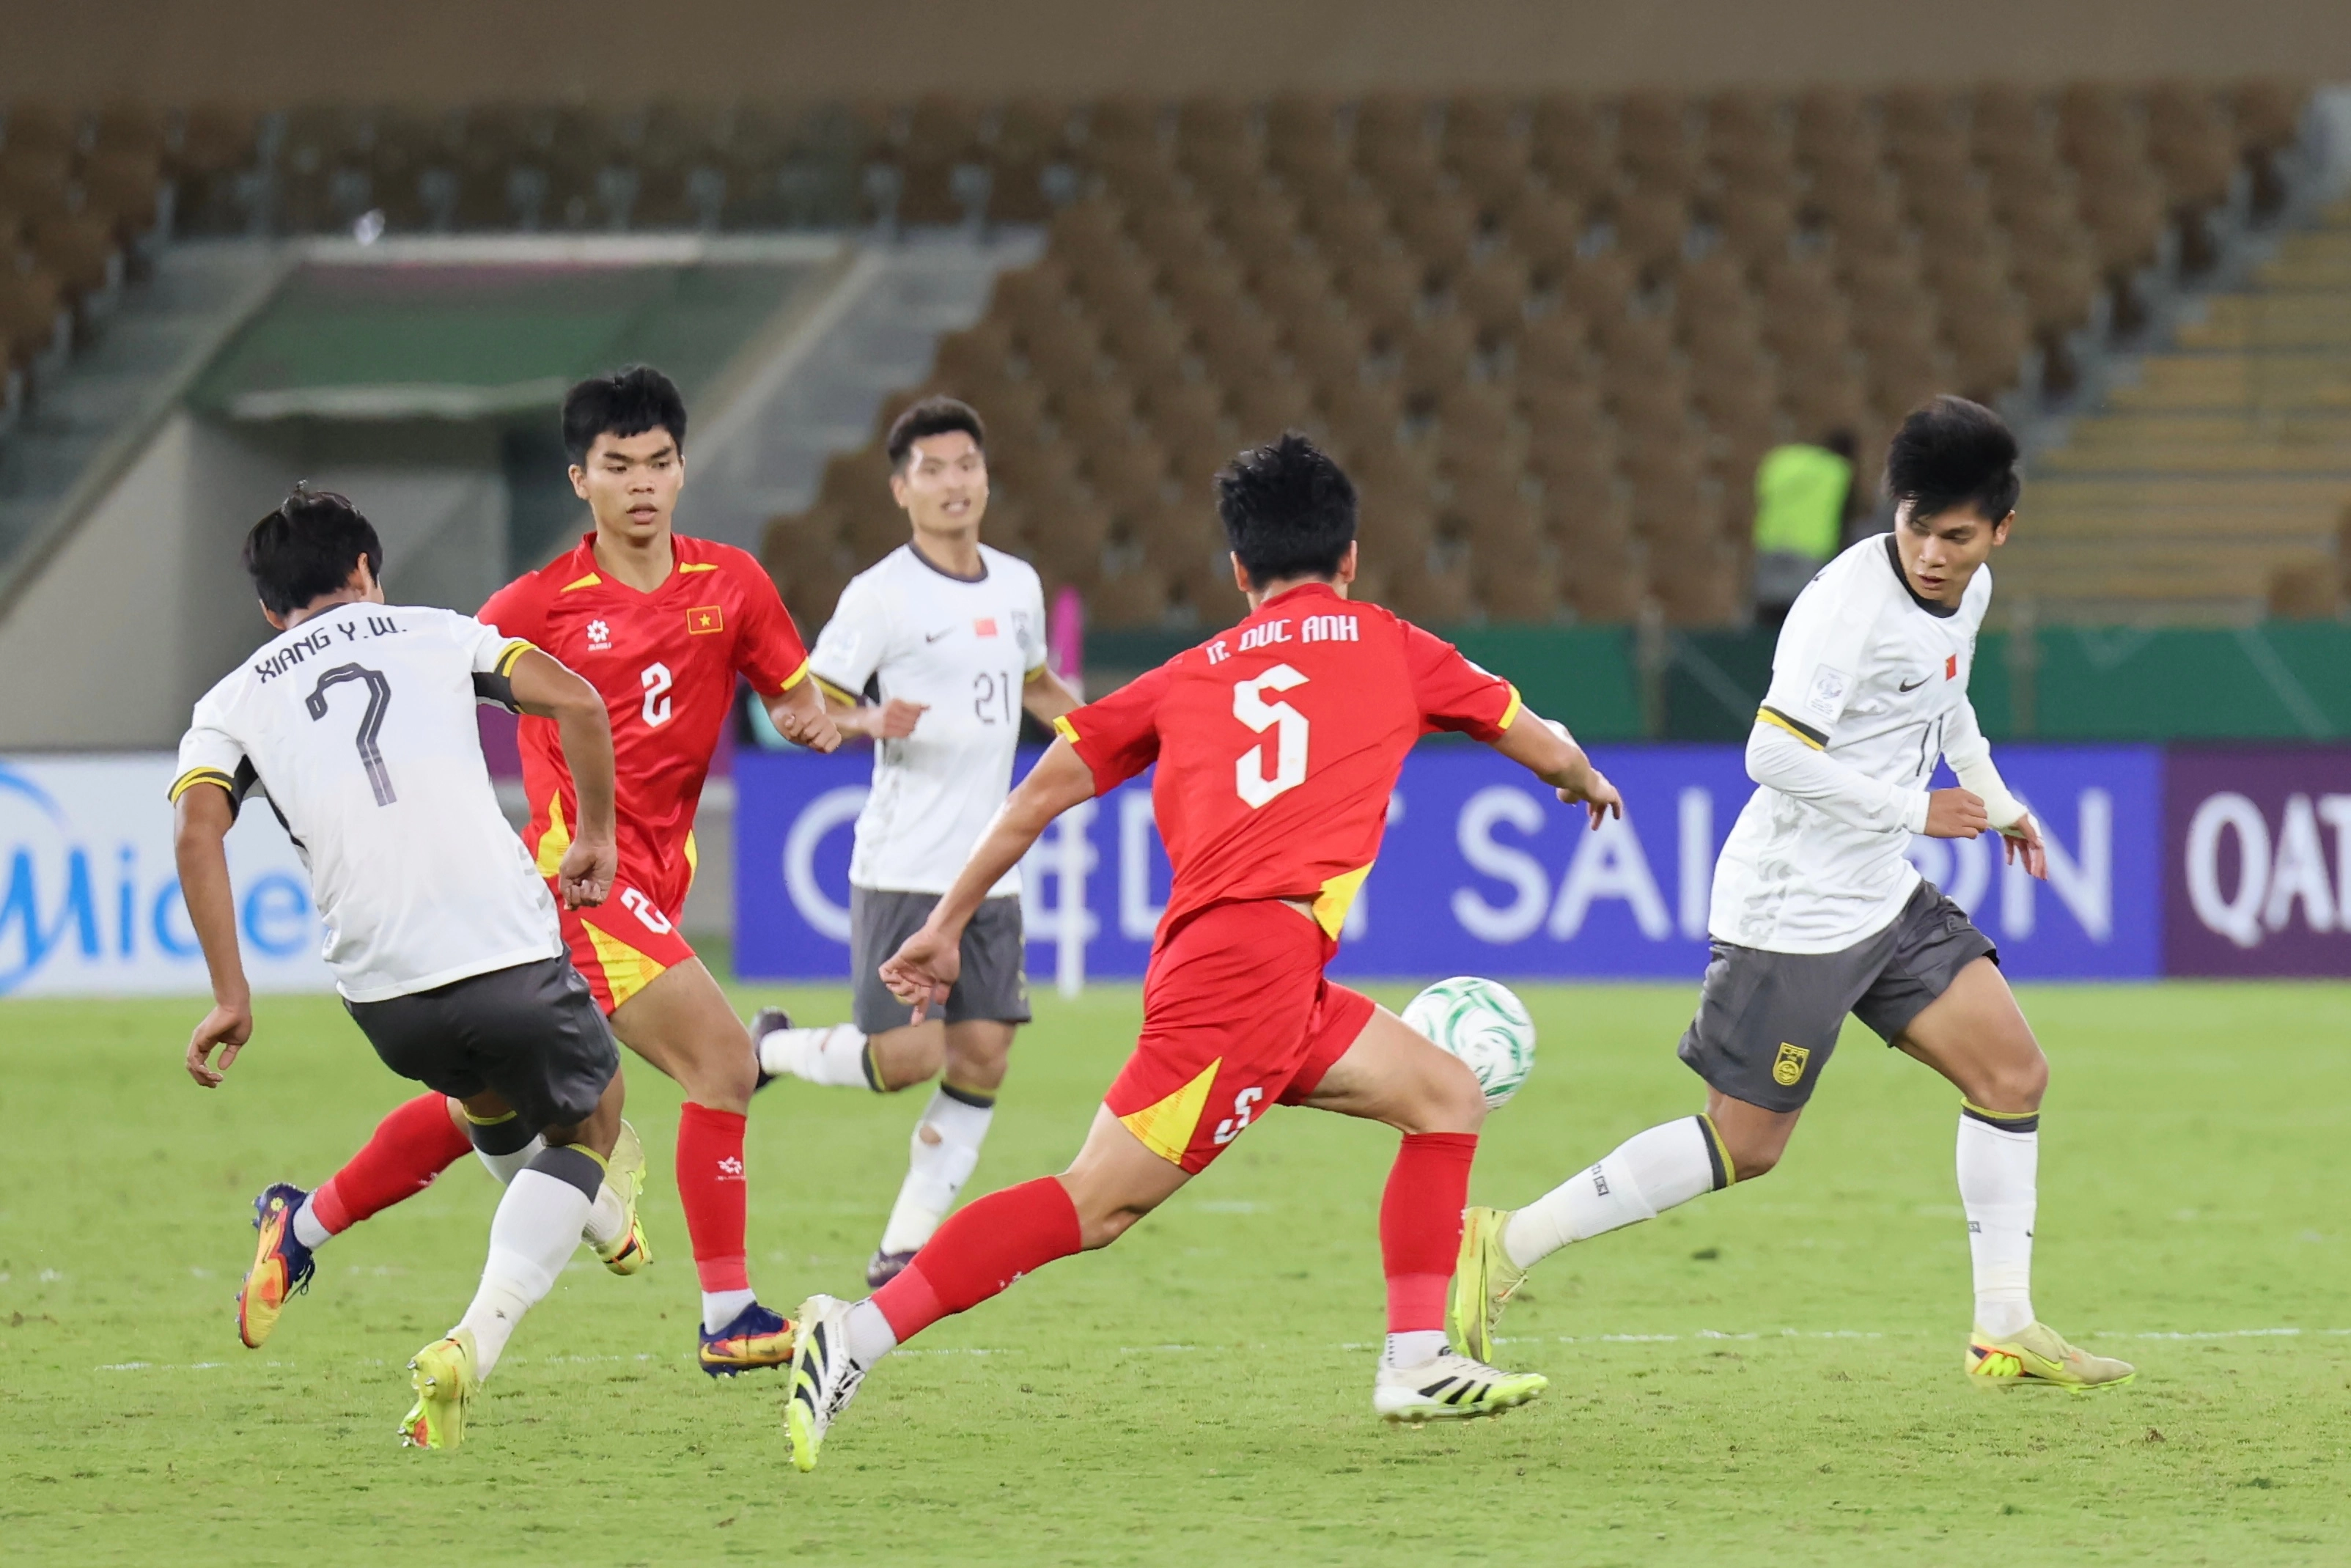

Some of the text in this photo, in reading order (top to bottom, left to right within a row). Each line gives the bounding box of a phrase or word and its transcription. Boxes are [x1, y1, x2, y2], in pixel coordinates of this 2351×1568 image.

[254, 616, 408, 684] XIANG Y.W.
[1238, 619, 1293, 652] DUC
[1301, 615, 1359, 643] ANH
[641, 661, 672, 728] 2
[974, 671, 1010, 724] 21
[305, 662, 397, 807] 7
[1232, 663, 1311, 809] 5
[620, 886, 672, 935] 2
